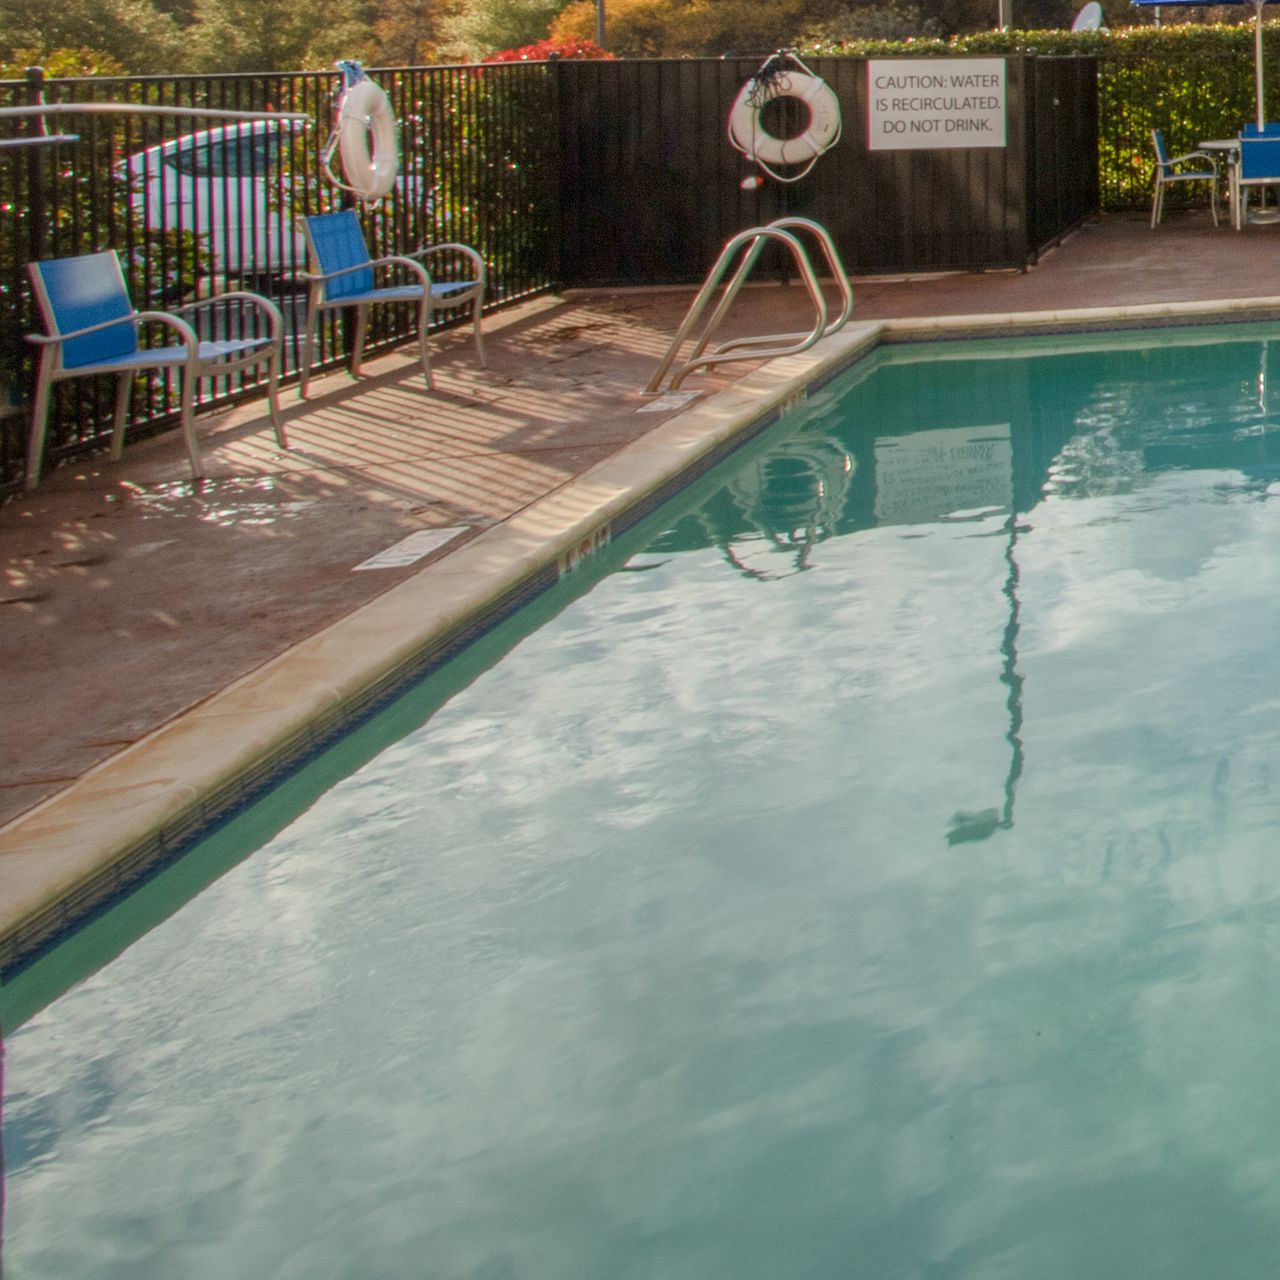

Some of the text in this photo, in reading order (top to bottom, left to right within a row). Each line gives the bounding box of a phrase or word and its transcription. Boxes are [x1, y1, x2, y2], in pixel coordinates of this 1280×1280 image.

[875, 74, 999, 89] CAUTION: WATER
[876, 96, 1001, 111] IS RECIRCULATED.
[883, 119, 993, 133] DO NOT DRINK.
